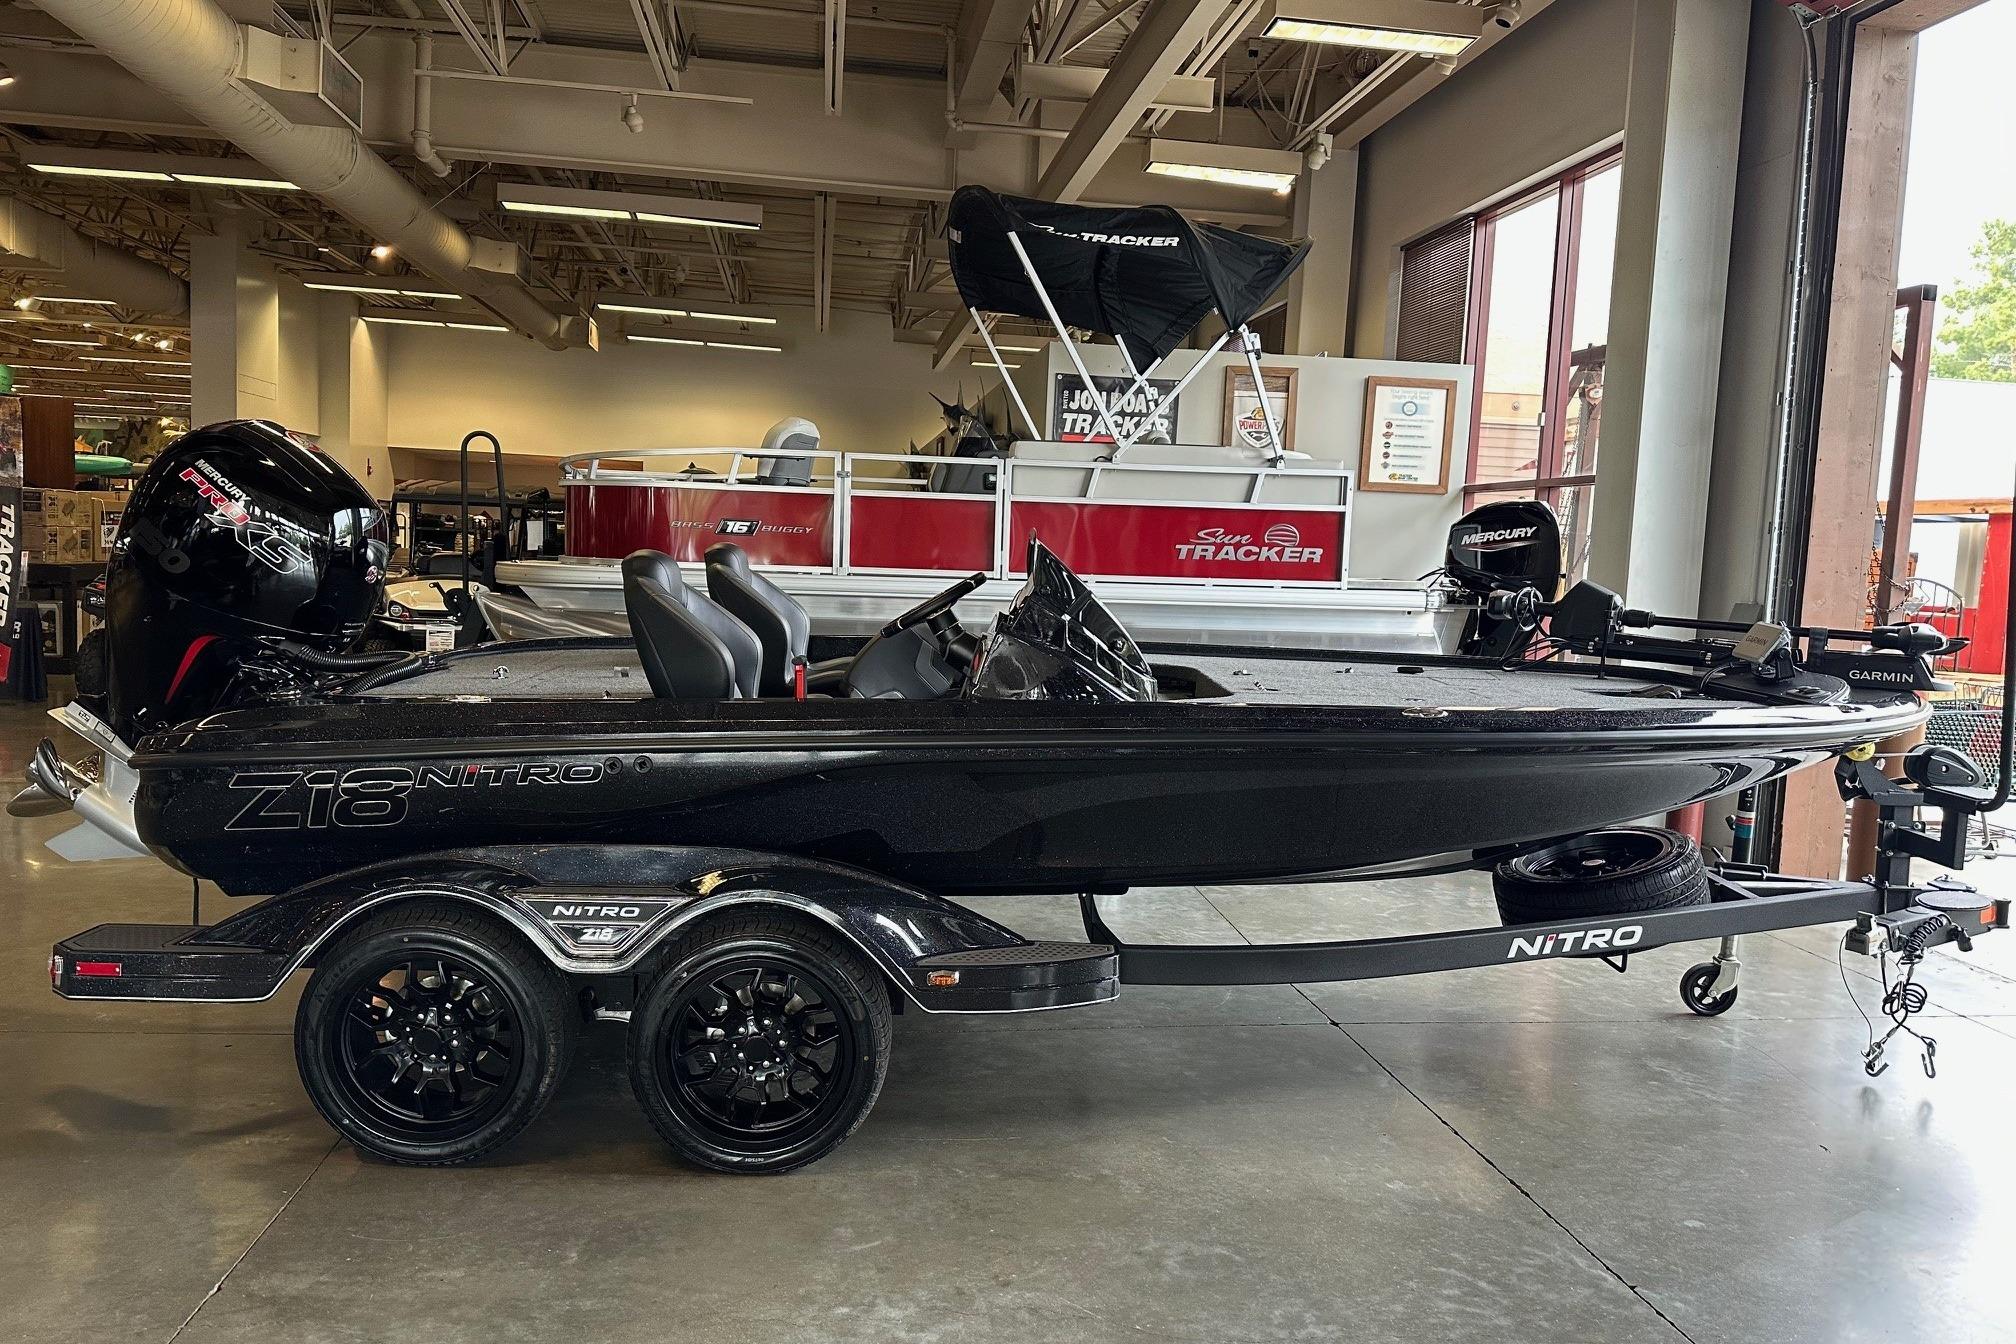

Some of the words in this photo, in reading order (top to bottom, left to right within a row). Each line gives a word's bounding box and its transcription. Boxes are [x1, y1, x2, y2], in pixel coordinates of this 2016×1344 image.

[1081, 232, 1180, 247] TRACKER
[1111, 392, 1170, 415] BOAS
[194, 459, 252, 500] MERCURY
[179, 467, 250, 525] PRO
[670, 520, 715, 529] BASS
[725, 521, 751, 533] 16
[761, 525, 813, 534] BUGGY
[1189, 528, 1253, 544] Sun
[1460, 526, 1538, 545] MERCURY
[204, 513, 313, 574] XS
[1175, 544, 1324, 563] TRACKER
[0, 504, 15, 627] TRACKER
[1848, 670, 1914, 683] GARMIN
[224, 767, 414, 830] Z18
[579, 927, 614, 941] Z18
